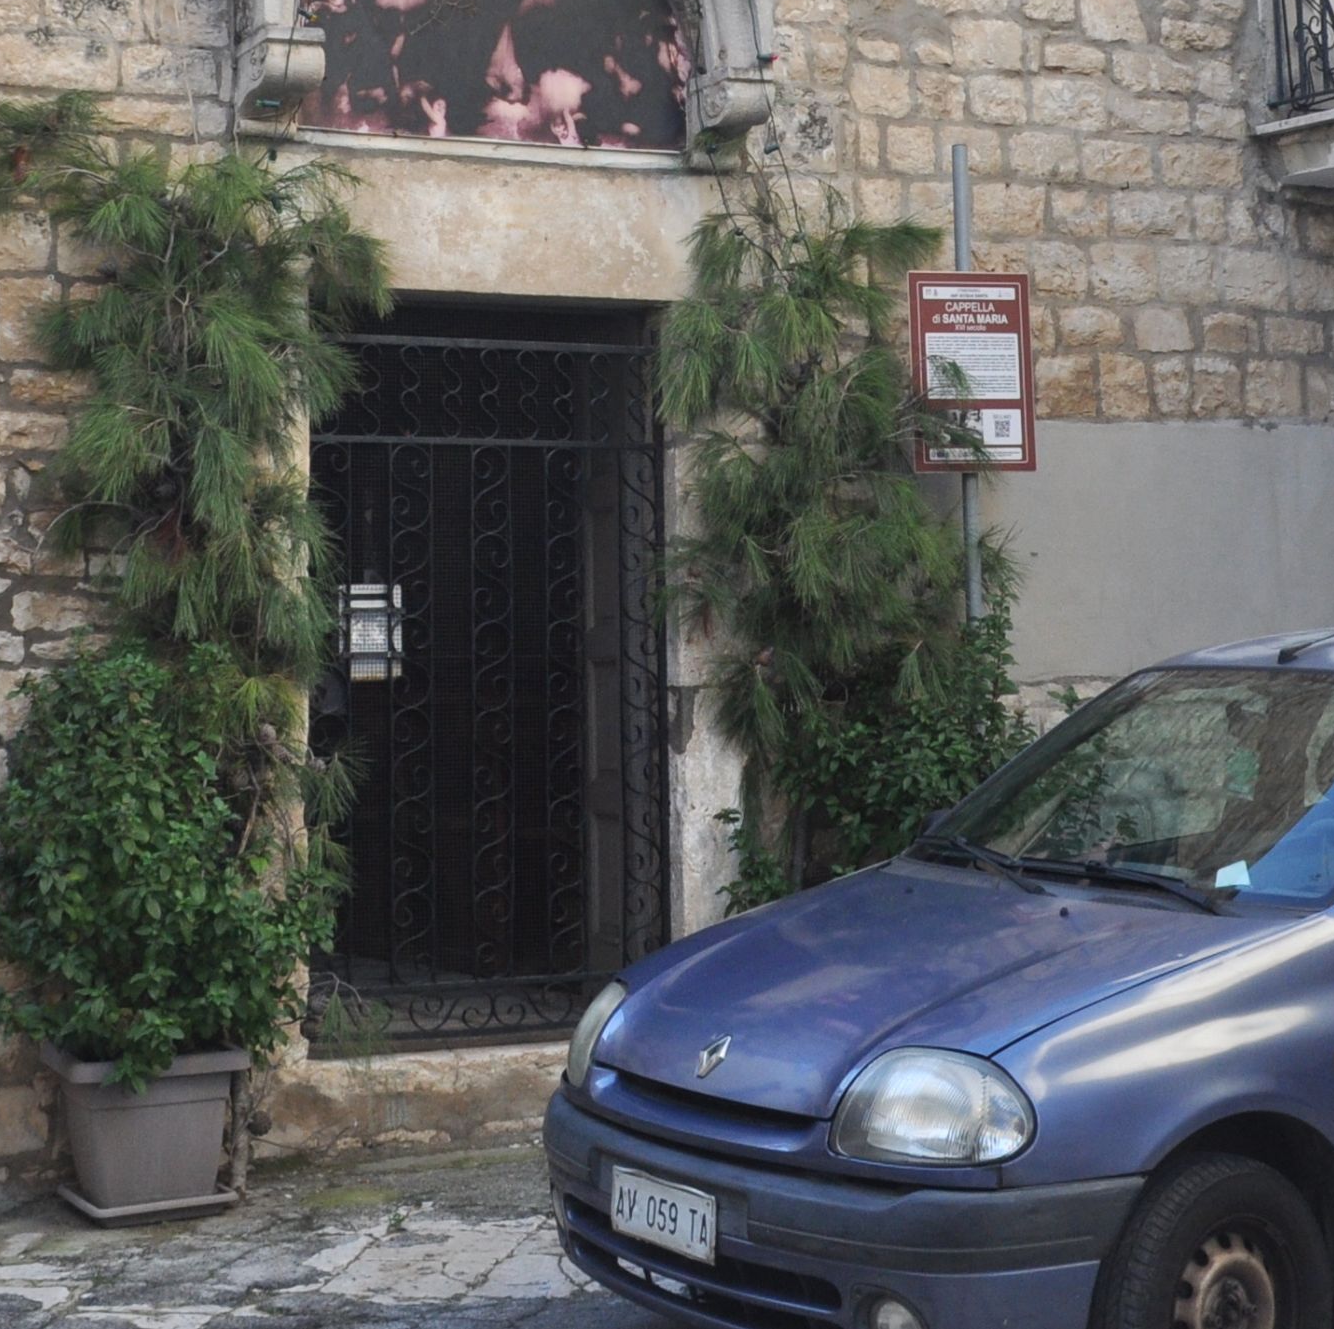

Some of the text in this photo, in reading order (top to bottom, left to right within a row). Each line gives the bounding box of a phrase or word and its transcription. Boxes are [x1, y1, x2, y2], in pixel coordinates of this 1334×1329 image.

[945, 302, 995, 312] CAPPELLA
[932, 314, 1008, 324] di SANTA MARIA
[646, 1196, 678, 1235] 059
[689, 1209, 707, 1246] TA
